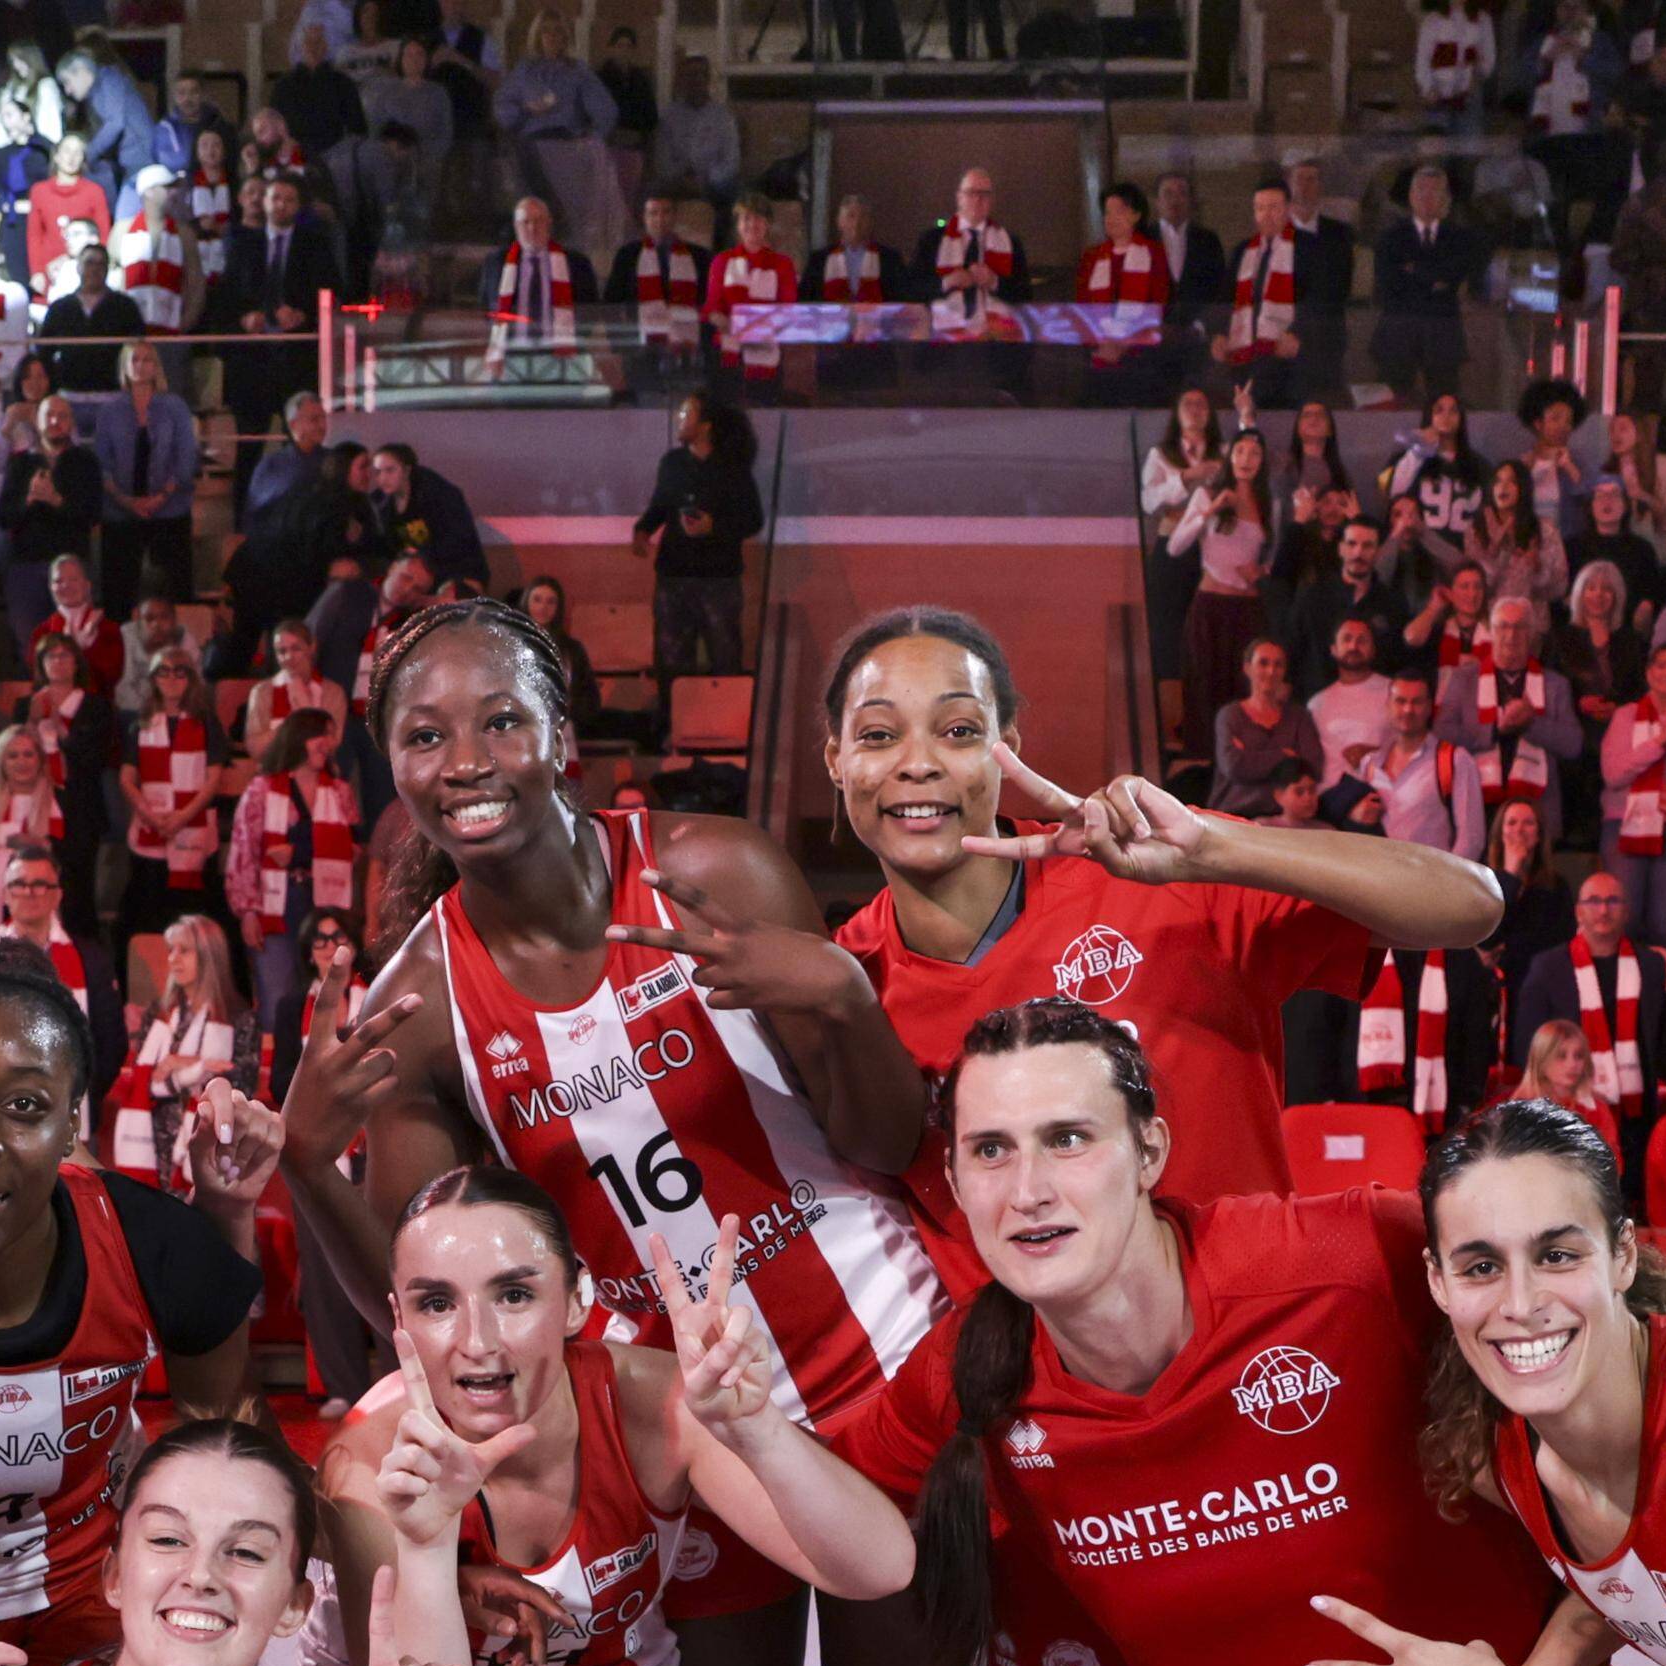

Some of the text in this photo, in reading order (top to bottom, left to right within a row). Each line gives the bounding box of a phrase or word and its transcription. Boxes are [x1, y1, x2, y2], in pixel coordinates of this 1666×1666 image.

[1053, 938, 1144, 991] MBA
[491, 1056, 530, 1079] errea
[509, 1027, 696, 1131] MONACO
[587, 1128, 703, 1228] 16
[763, 1235, 787, 1260] DE
[790, 1203, 828, 1238] MER
[1231, 1361, 1341, 1415] MBA
[1010, 1453, 1055, 1470] errea
[1068, 1495, 1349, 1568] SOCIÉTÉ DES BAINS DE MER
